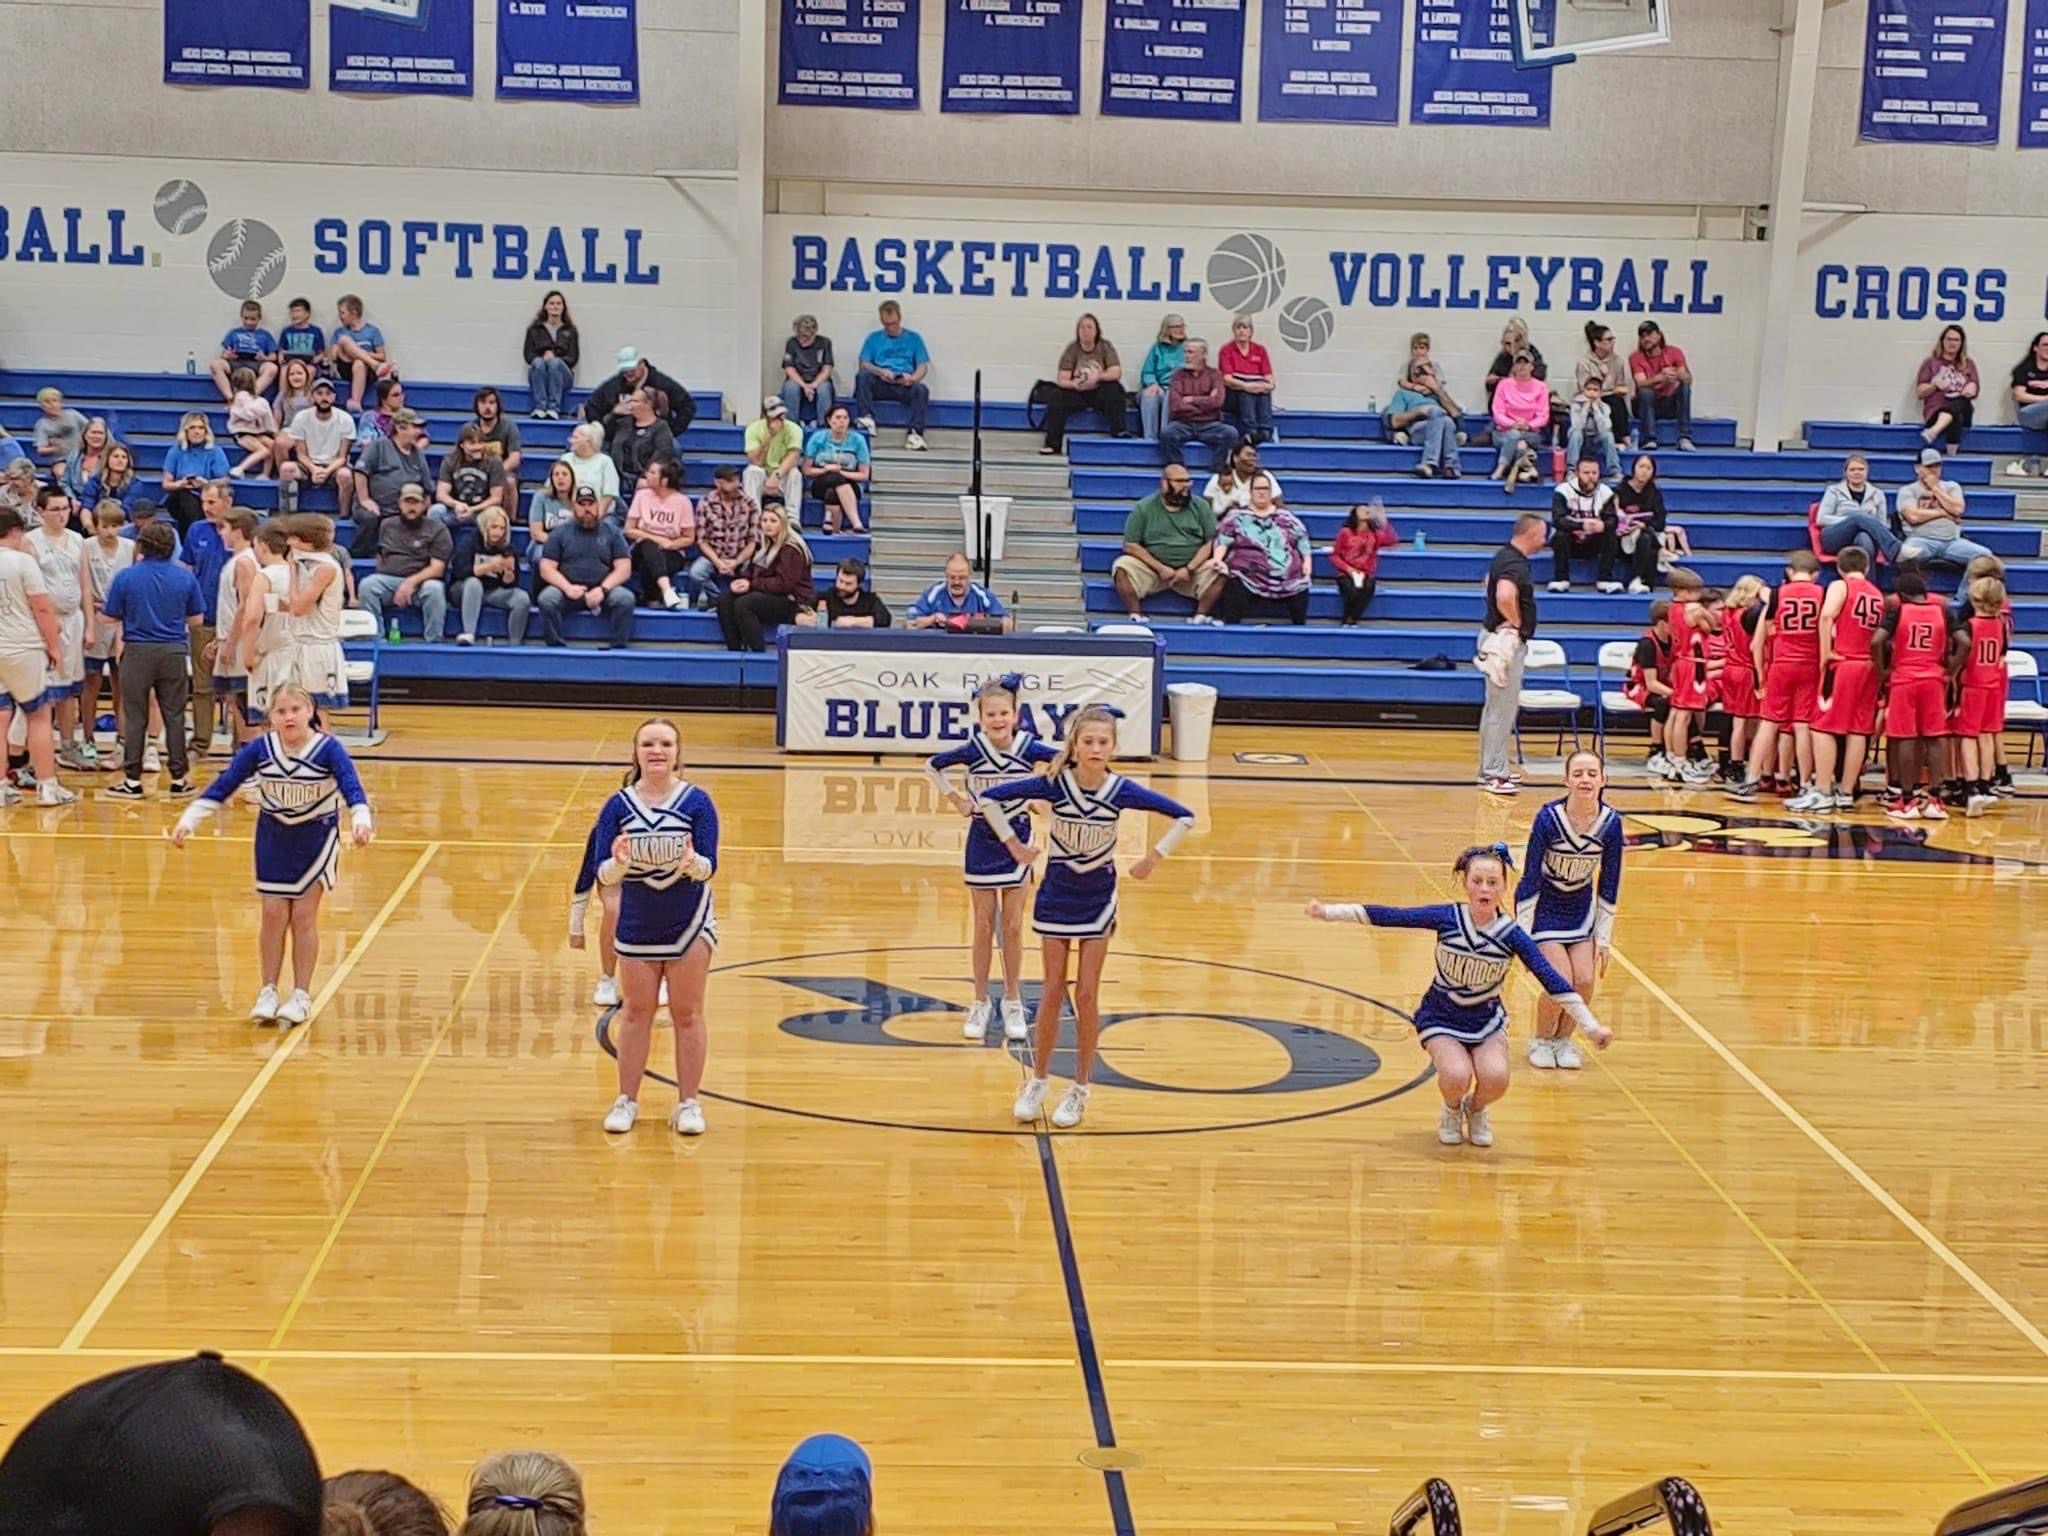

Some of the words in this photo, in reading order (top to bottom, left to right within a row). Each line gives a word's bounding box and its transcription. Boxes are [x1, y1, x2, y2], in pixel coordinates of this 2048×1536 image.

[0, 206, 144, 265] ALL
[314, 218, 660, 285] SOFTBALL
[791, 235, 1201, 302] BASKETBALL
[1329, 251, 1723, 314] VOLLEYBALL
[1815, 264, 2007, 322] CROSS
[649, 508, 675, 524] YOU
[1781, 599, 1818, 632] 22
[1852, 594, 1882, 629] 45
[1907, 622, 1933, 650] 12
[1977, 638, 1998, 665] 10
[877, 670, 940, 689] OAK
[962, 673, 1065, 691] RGE
[825, 698, 1080, 741] BLUEAY
